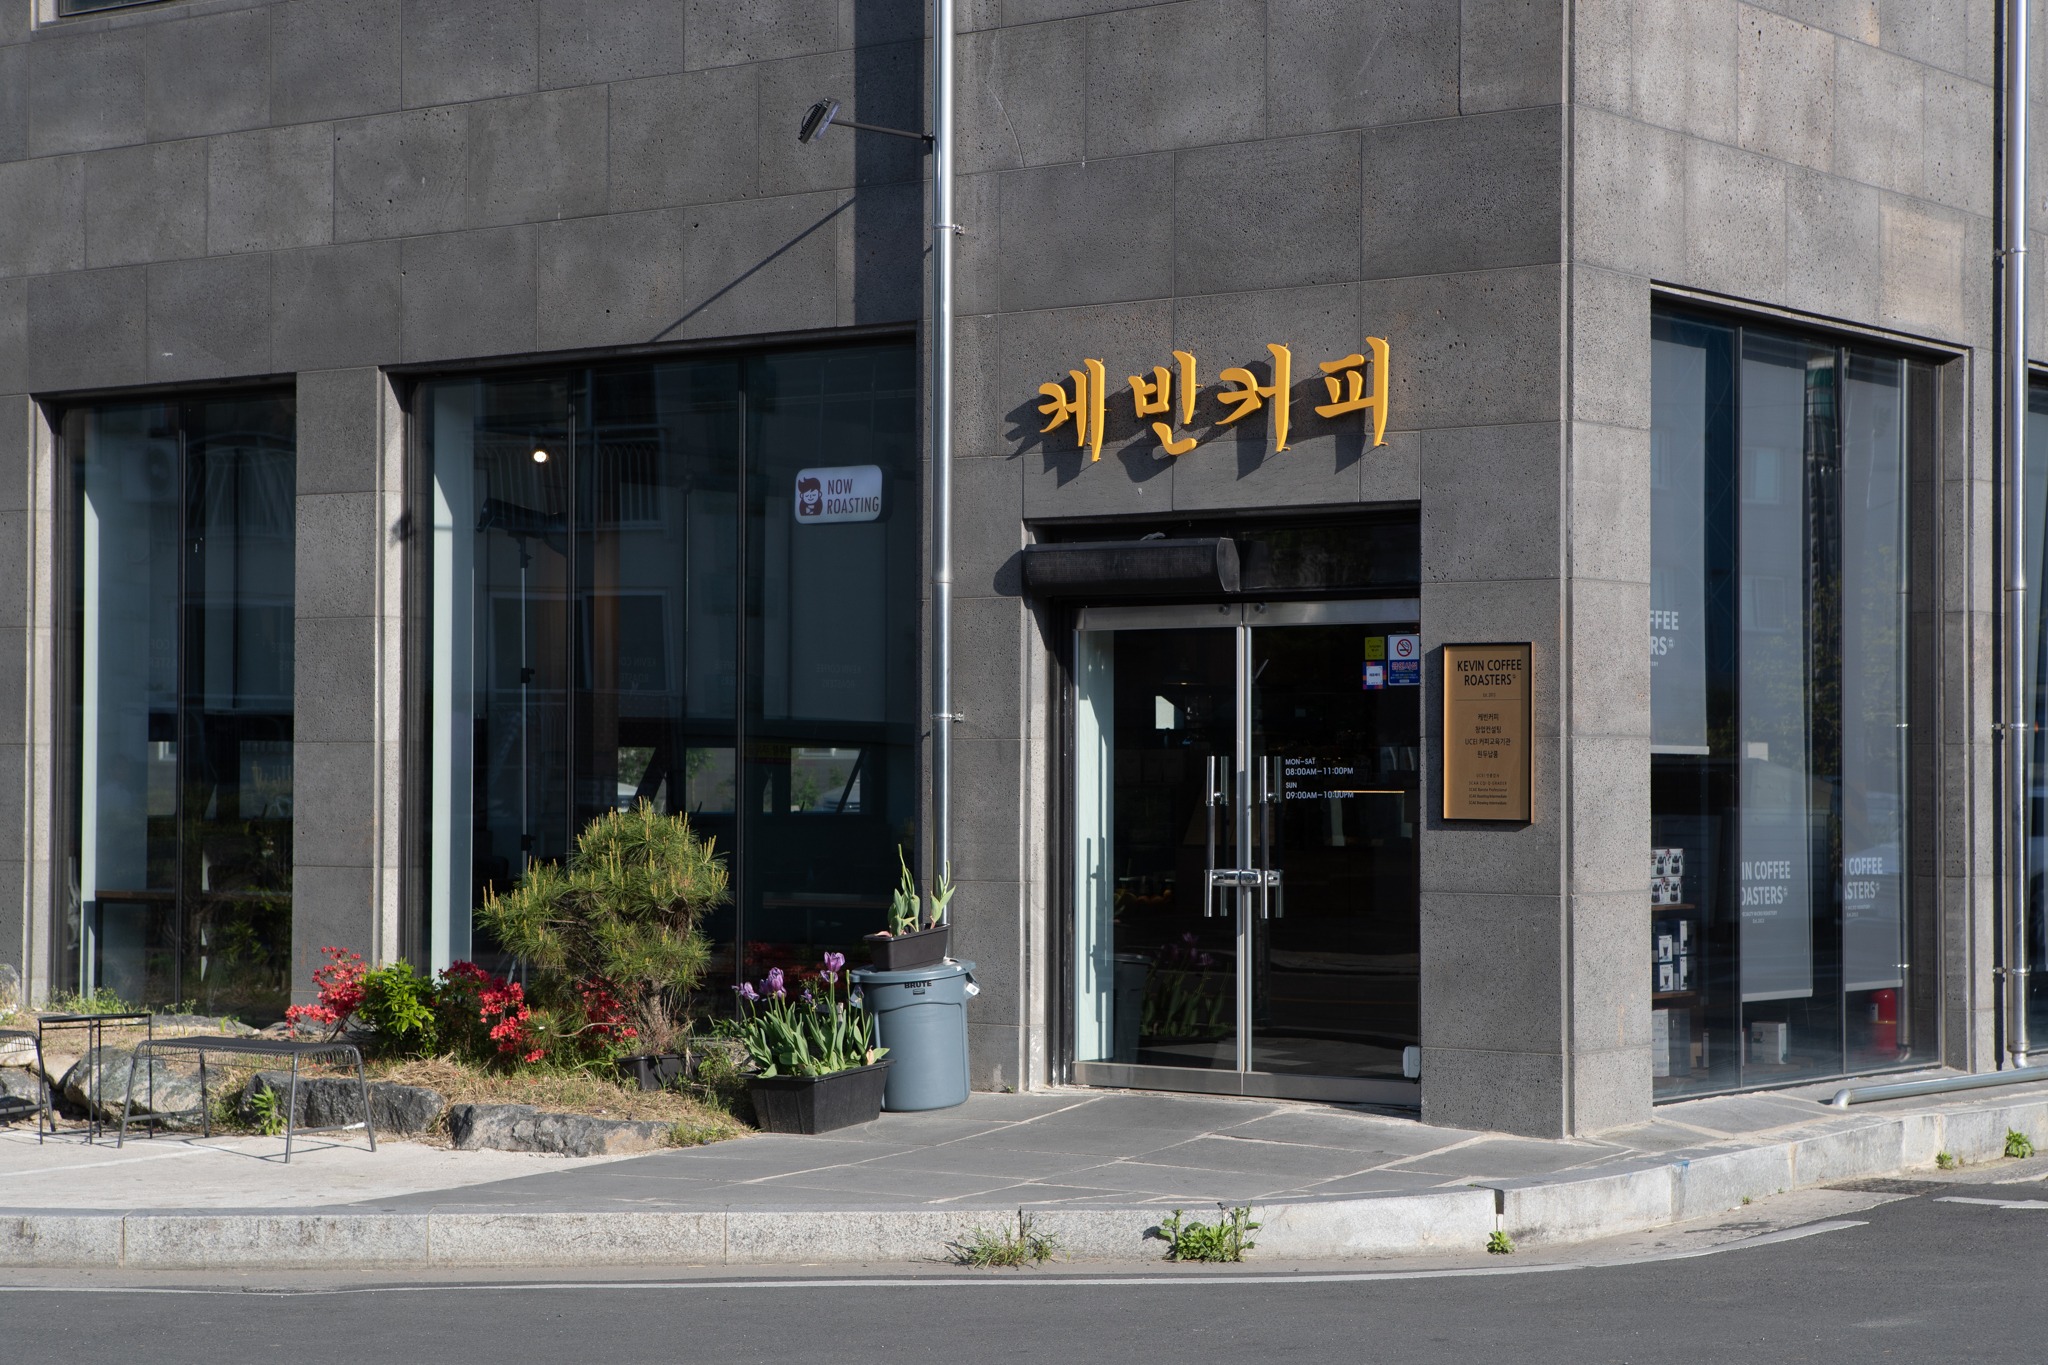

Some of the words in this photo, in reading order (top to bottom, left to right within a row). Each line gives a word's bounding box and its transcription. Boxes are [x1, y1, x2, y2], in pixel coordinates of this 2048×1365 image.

[1037, 336, 1390, 462] 케빈커피
[827, 478, 853, 495] NOW
[826, 496, 880, 515] ROASTING
[1457, 660, 1485, 672] KEVIN
[1487, 659, 1522, 671] COFFEE
[1464, 673, 1512, 686] ROASTERS
[1477, 713, 1499, 722] 케빈커피
[1464, 738, 1477, 746] UCEI
[1479, 737, 1511, 746] 커피교육기관
[1754, 860, 1791, 880] COFFEE
[1848, 857, 1883, 876] COFFEE
[904, 980, 932, 989] BRUTE
